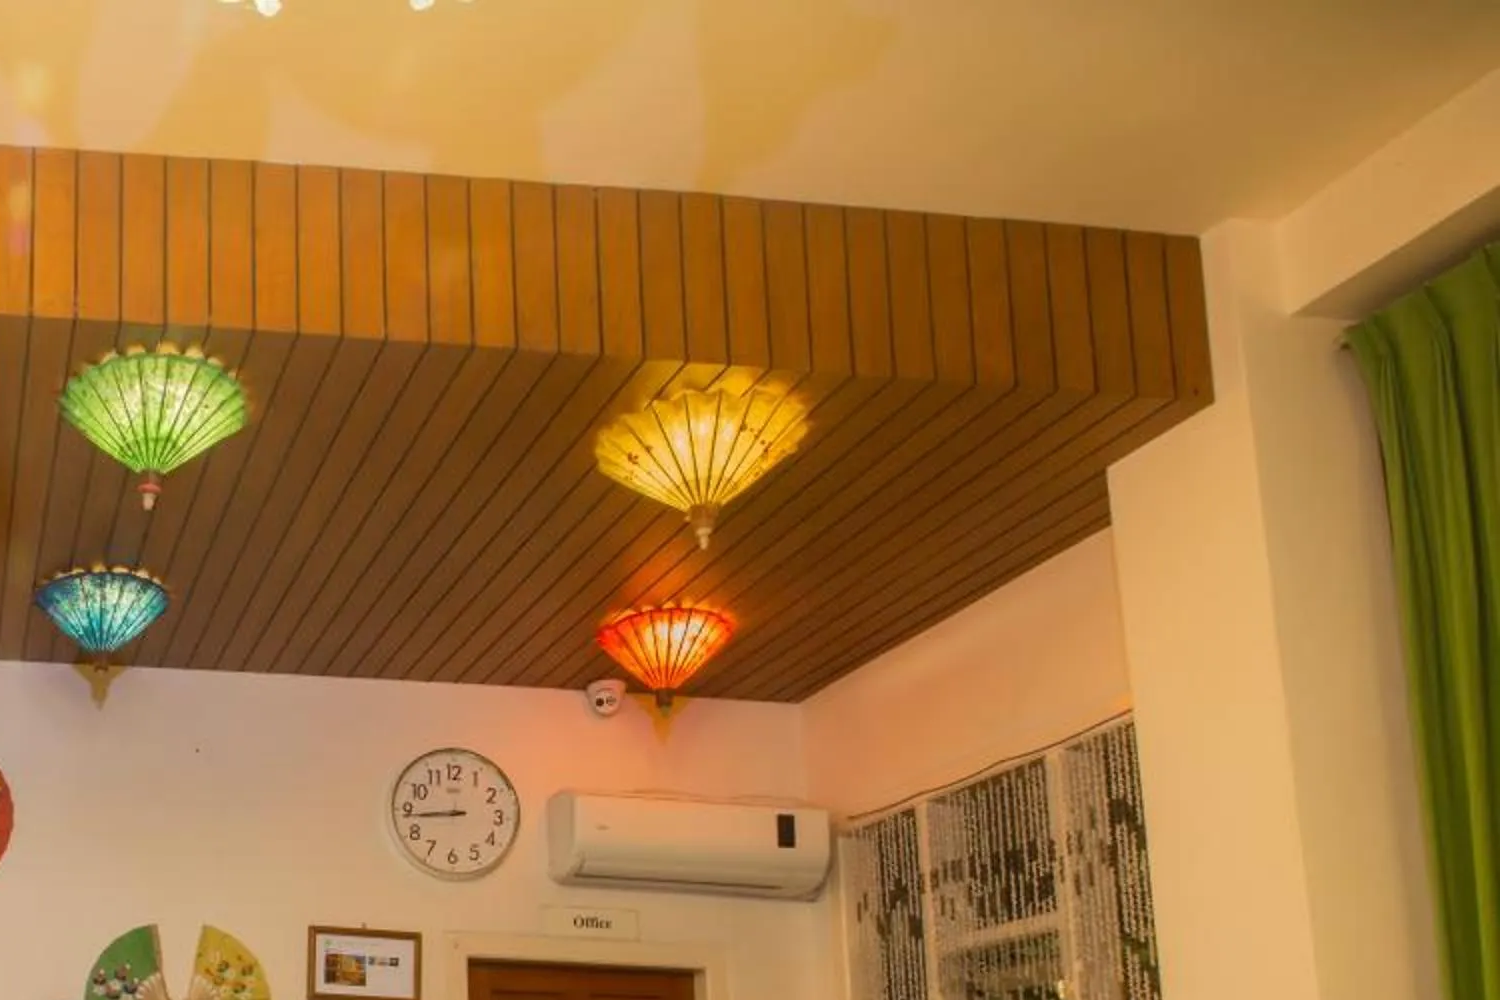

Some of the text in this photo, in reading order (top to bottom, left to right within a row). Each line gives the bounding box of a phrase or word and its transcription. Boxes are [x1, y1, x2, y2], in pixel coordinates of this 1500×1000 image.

[427, 769, 441, 785] 11
[446, 763, 462, 781] 12
[471, 771, 479, 787] 1
[411, 783, 428, 800] 10
[485, 787, 497, 804] 2
[402, 802, 414, 818] 9
[493, 809, 504, 826] 3
[409, 823, 421, 841] 8
[484, 831, 496, 846] 4
[425, 839, 437, 856] 7
[447, 848, 459, 864] 6
[468, 845, 480, 862] 5
[573, 916, 613, 930] Office
